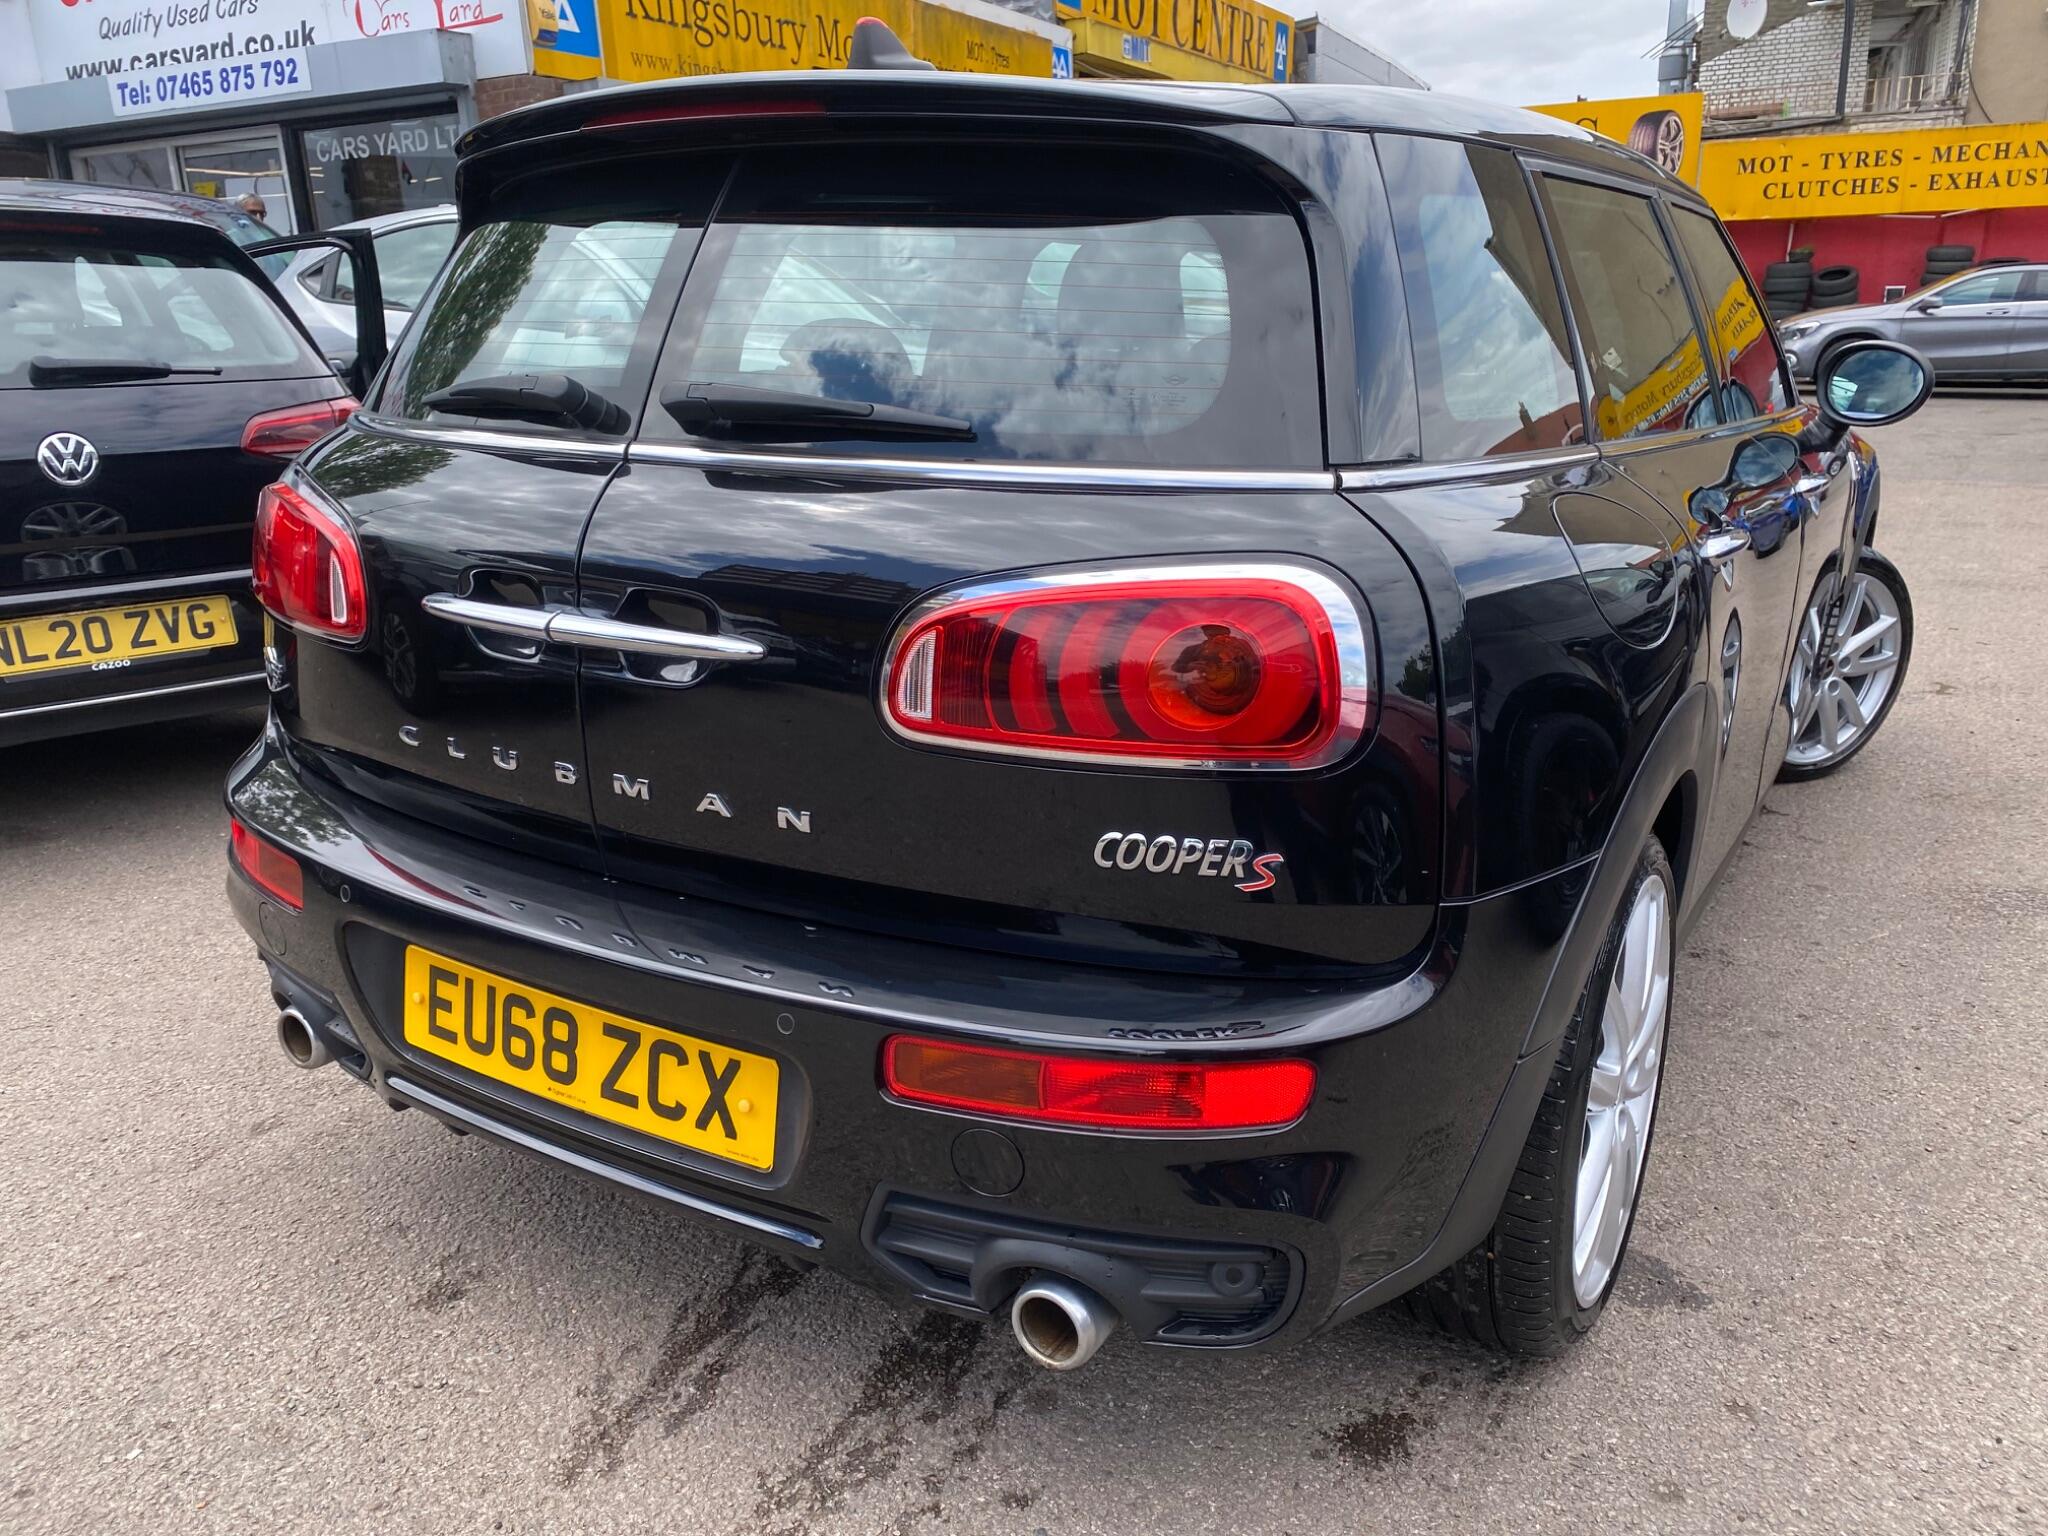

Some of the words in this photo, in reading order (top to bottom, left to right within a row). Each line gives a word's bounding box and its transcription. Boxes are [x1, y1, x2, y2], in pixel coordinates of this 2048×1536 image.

[99, 8, 163, 40] Quality
[166, 0, 209, 27] Used
[216, 0, 258, 19] Cars
[355, 0, 410, 37] Cars
[1171, 0, 1270, 73] CENTRE
[65, 20, 316, 81] www.carsyard.co.uk
[116, 80, 151, 107] Tel:
[156, 70, 214, 102] 07465
[219, 63, 255, 94] 875
[260, 57, 299, 88] 792
[316, 136, 370, 162] CARS
[374, 129, 428, 156] YARD
[1737, 155, 1793, 175] MOT
[1820, 149, 1903, 170] TYRES
[1931, 140, 2048, 163] MECHAN
[1762, 176, 1900, 200] CLUTCHES
[124, 604, 215, 649] ZVG
[399, 725, 812, 833] CLUBMAN
[427, 964, 580, 1086] EU68
[600, 1023, 741, 1140] ZCX
